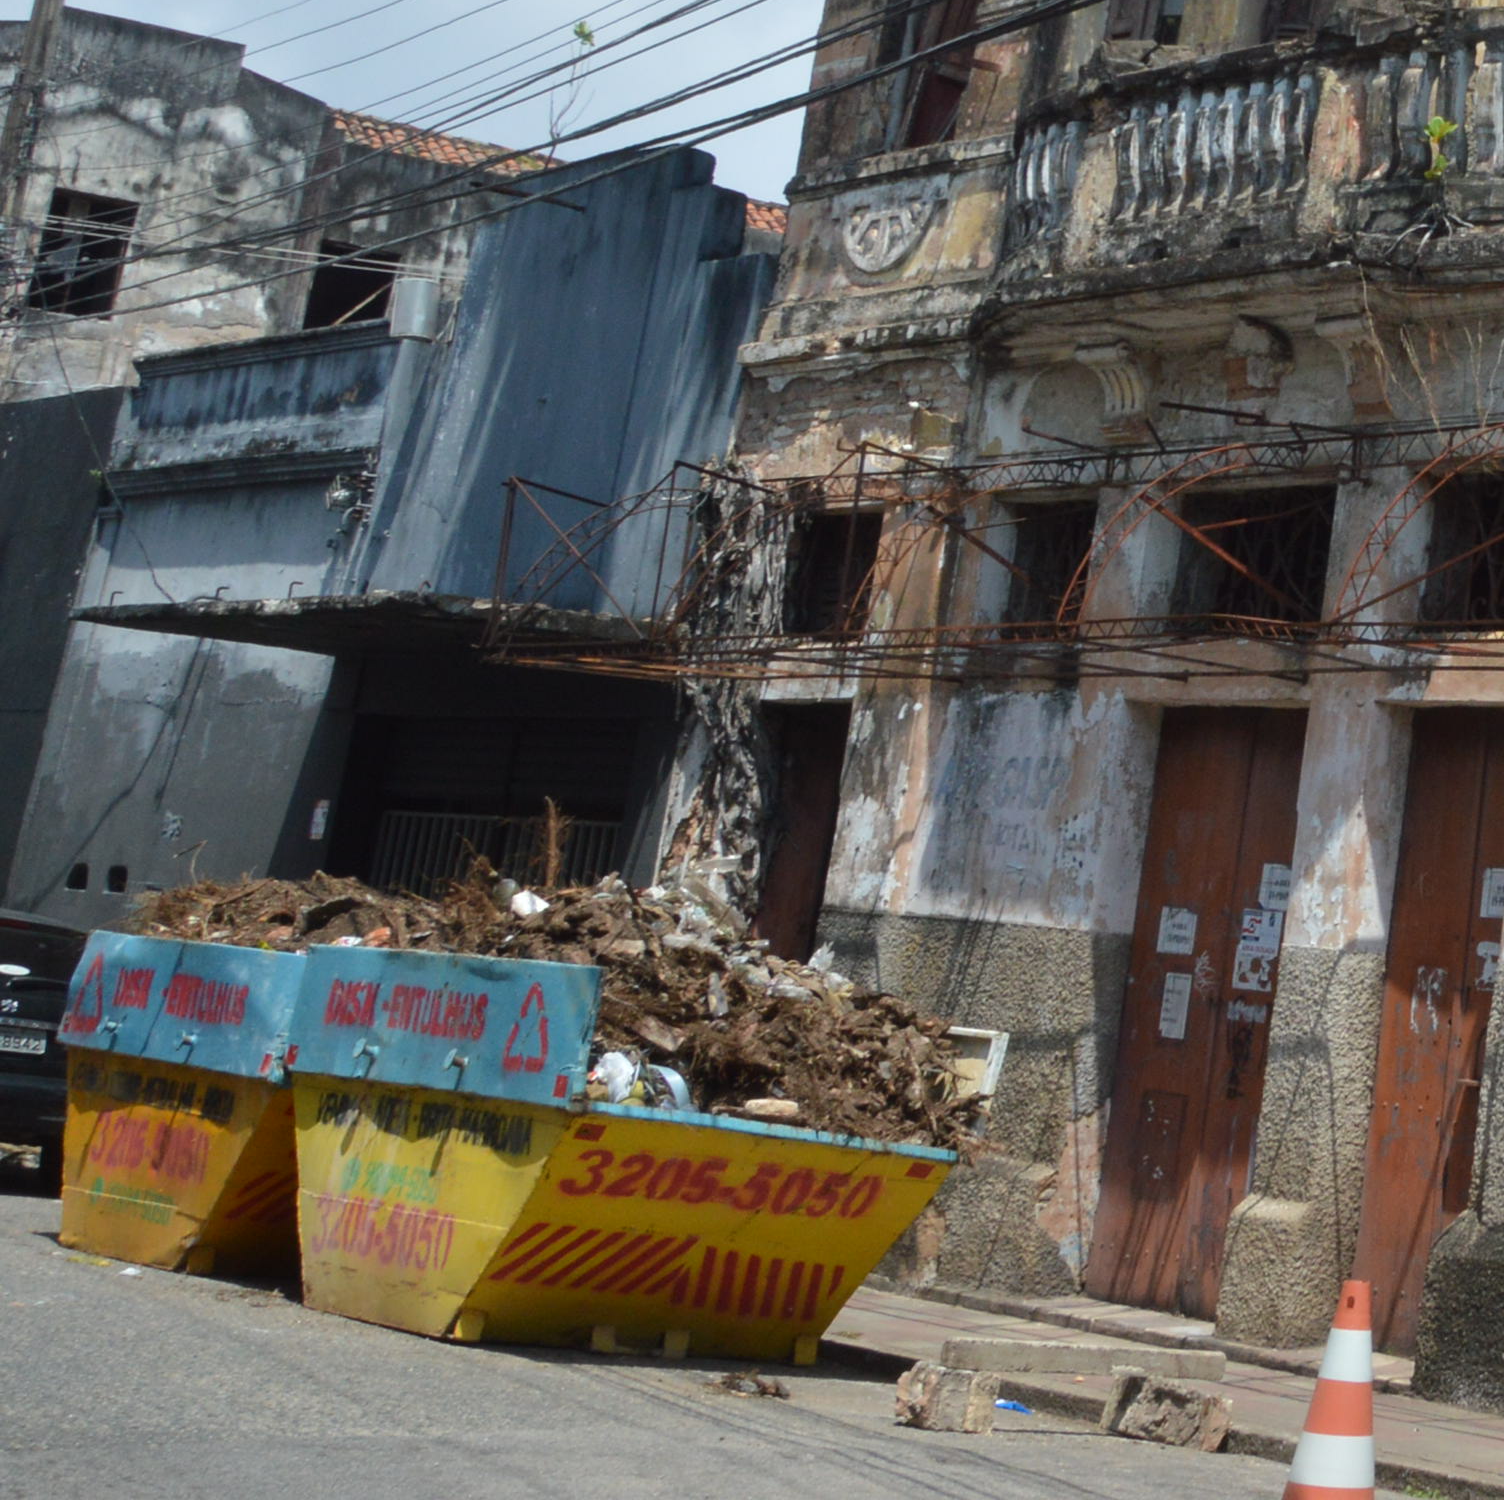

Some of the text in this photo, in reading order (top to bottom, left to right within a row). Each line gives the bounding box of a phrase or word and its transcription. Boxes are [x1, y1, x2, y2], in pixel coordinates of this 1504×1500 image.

[112, 967, 156, 1010] DISK
[324, 979, 381, 1028] DISK
[558, 1149, 884, 1219] 3205-5050
[312, 1191, 455, 1271] 3205-5050
